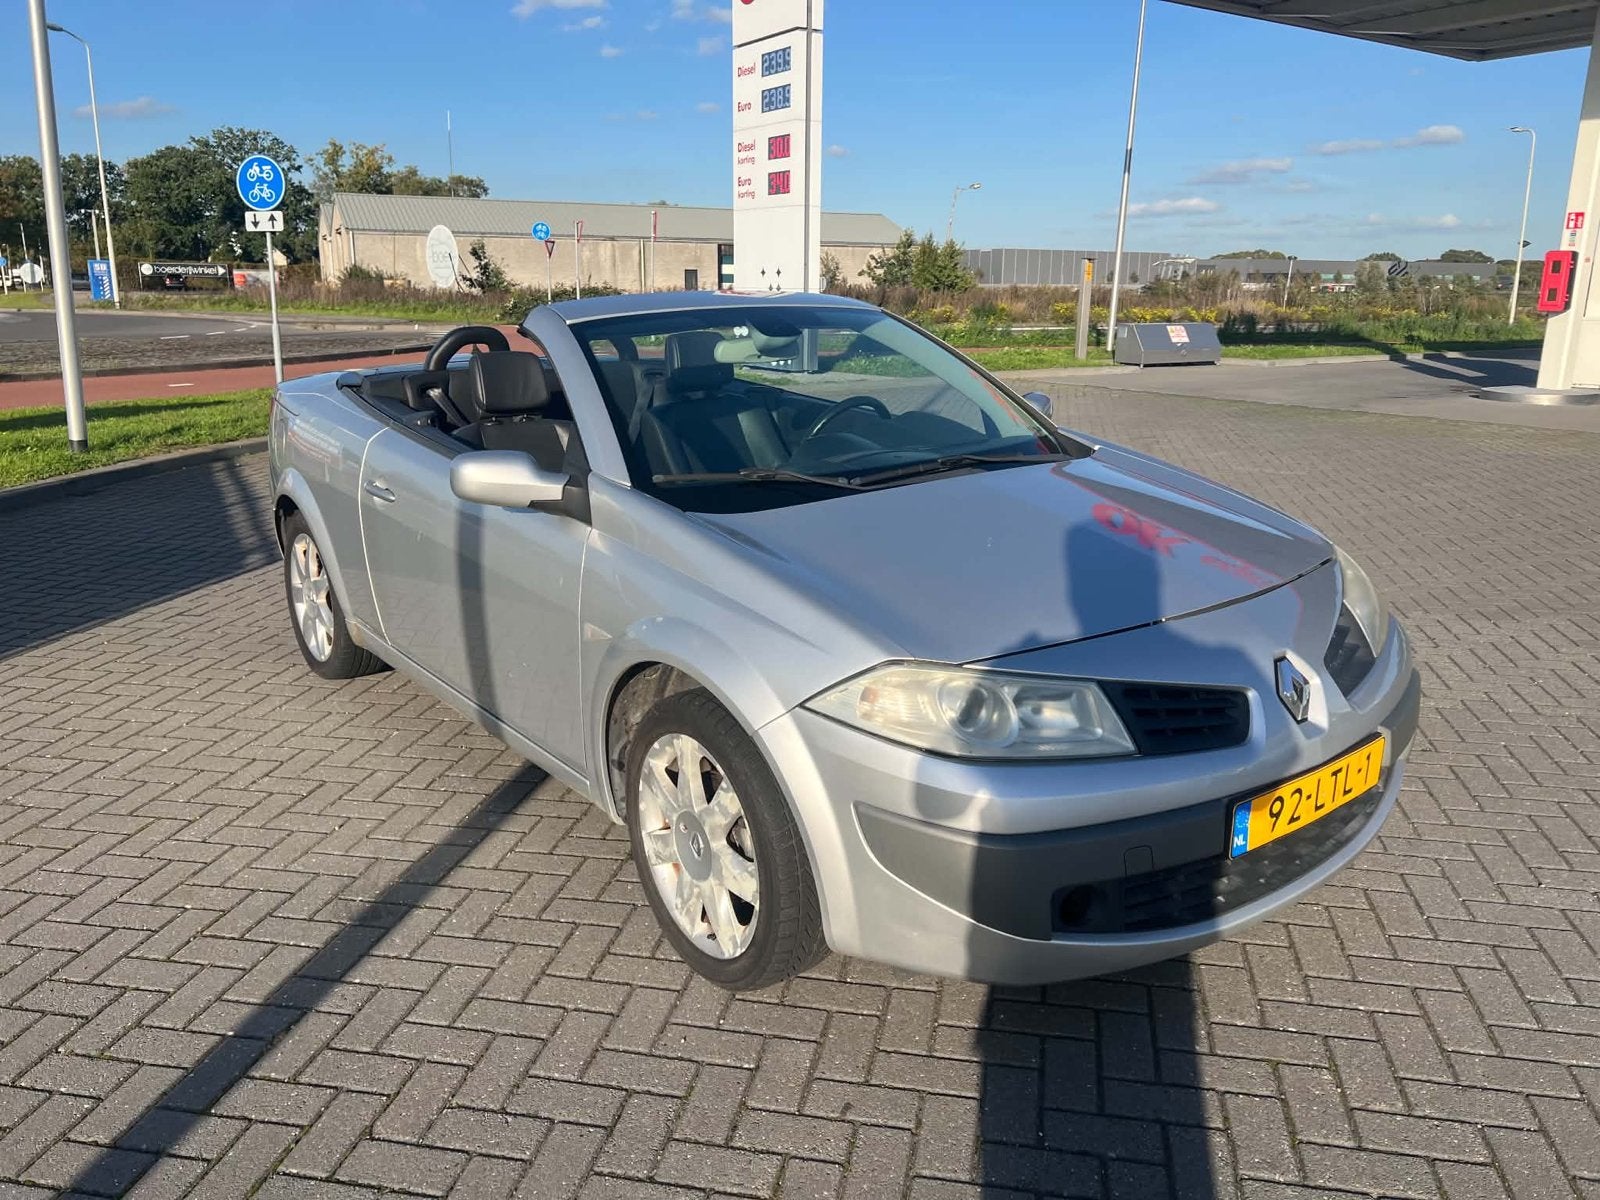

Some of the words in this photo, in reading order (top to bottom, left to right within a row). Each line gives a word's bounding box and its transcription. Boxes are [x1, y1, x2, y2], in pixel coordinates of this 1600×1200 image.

[737, 62, 756, 77] Diesel
[737, 101, 752, 112] Euro
[737, 139, 756, 152] Diesel
[737, 156, 756, 165] korting
[737, 177, 752, 187] Euro
[737, 191, 756, 199] korting
[1268, 752, 1372, 833] 92-LTL-1
[1233, 834, 1246, 848] NL
